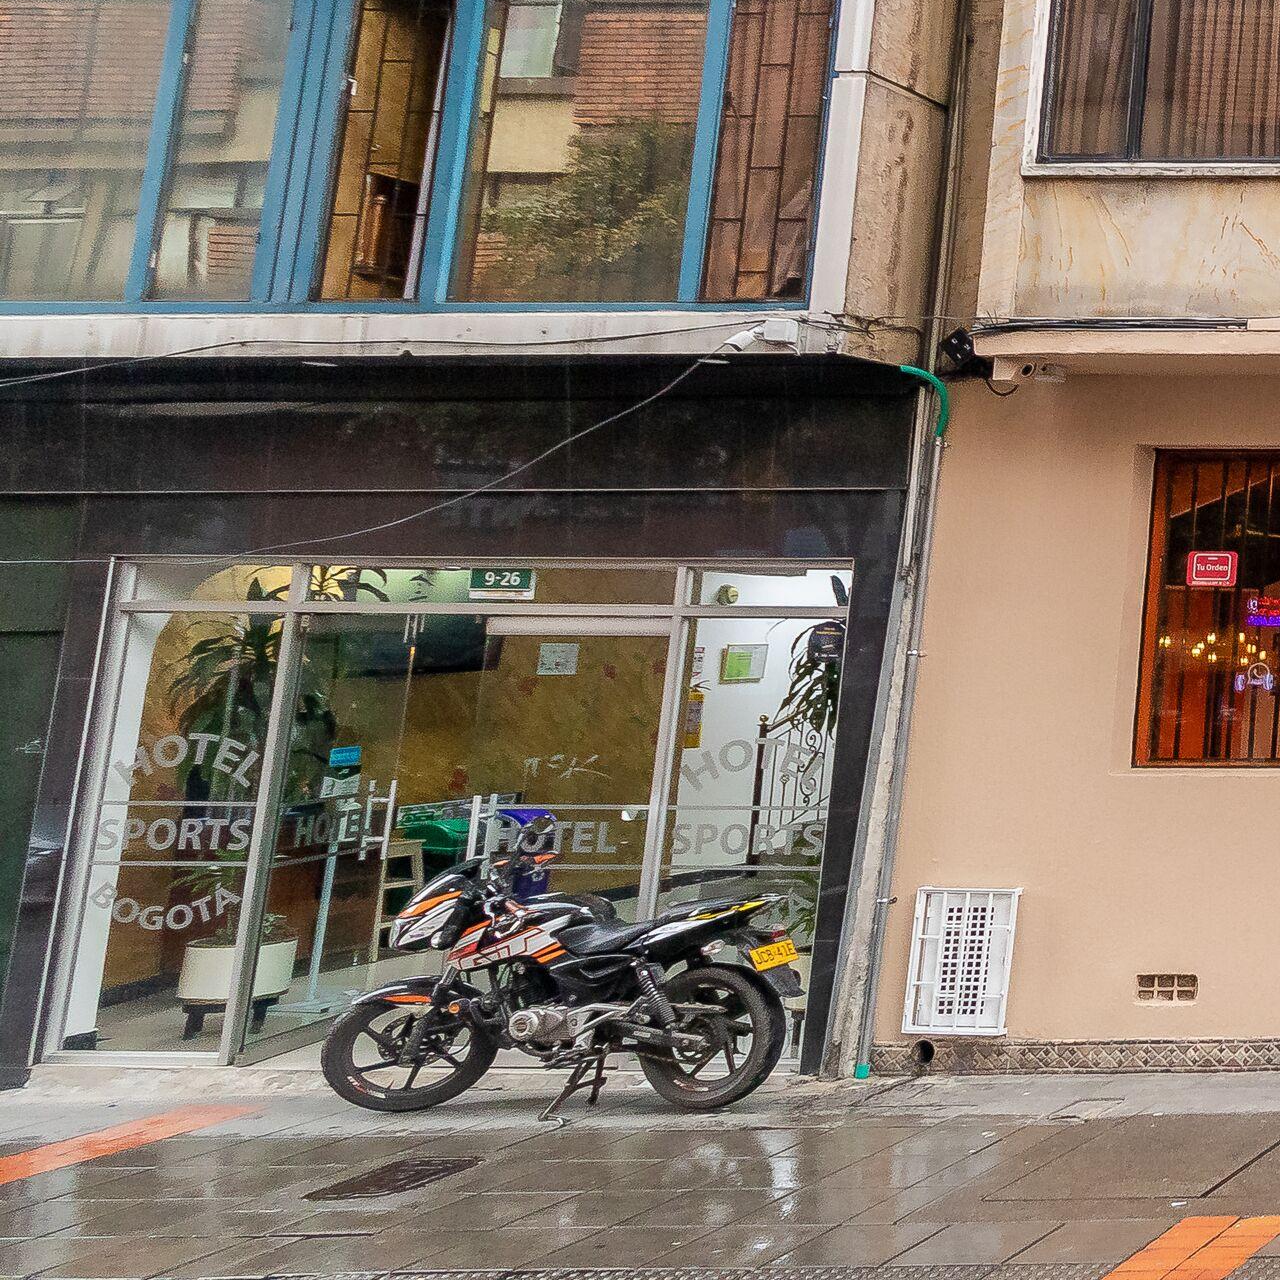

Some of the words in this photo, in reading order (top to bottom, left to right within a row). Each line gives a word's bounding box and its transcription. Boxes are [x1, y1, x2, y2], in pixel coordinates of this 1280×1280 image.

[484, 571, 521, 586] 9-26
[1196, 563, 1205, 571] Tu
[1205, 563, 1229, 571] Orden
[112, 732, 261, 788] HOTEL
[680, 737, 826, 792] HOTEL
[97, 817, 251, 851] SPORTS
[672, 822, 824, 857] SPORTS
[91, 881, 242, 931] BOGOTÁ
